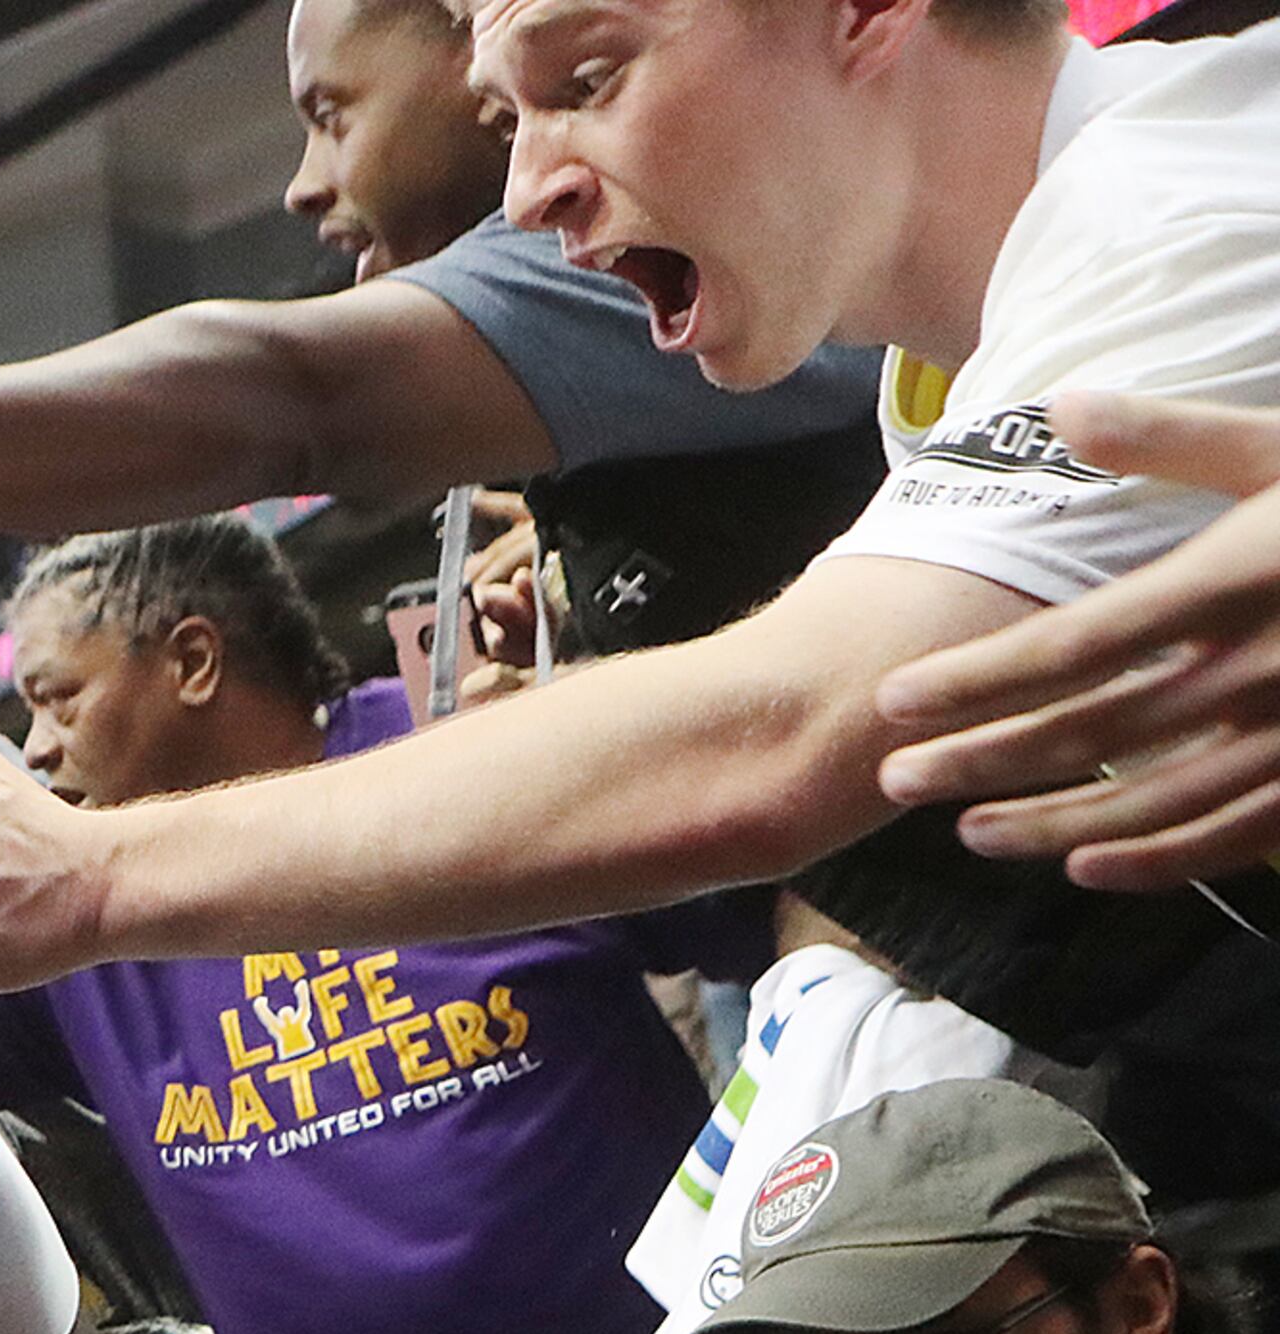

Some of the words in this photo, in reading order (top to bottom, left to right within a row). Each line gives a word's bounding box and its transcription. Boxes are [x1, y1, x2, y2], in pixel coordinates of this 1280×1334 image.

[154, 985, 530, 1144] MATTERS
[159, 1141, 259, 1170] UNITY
[267, 1102, 385, 1158] UNITED
[391, 1076, 465, 1118] FOR
[471, 1051, 542, 1094] ALL
